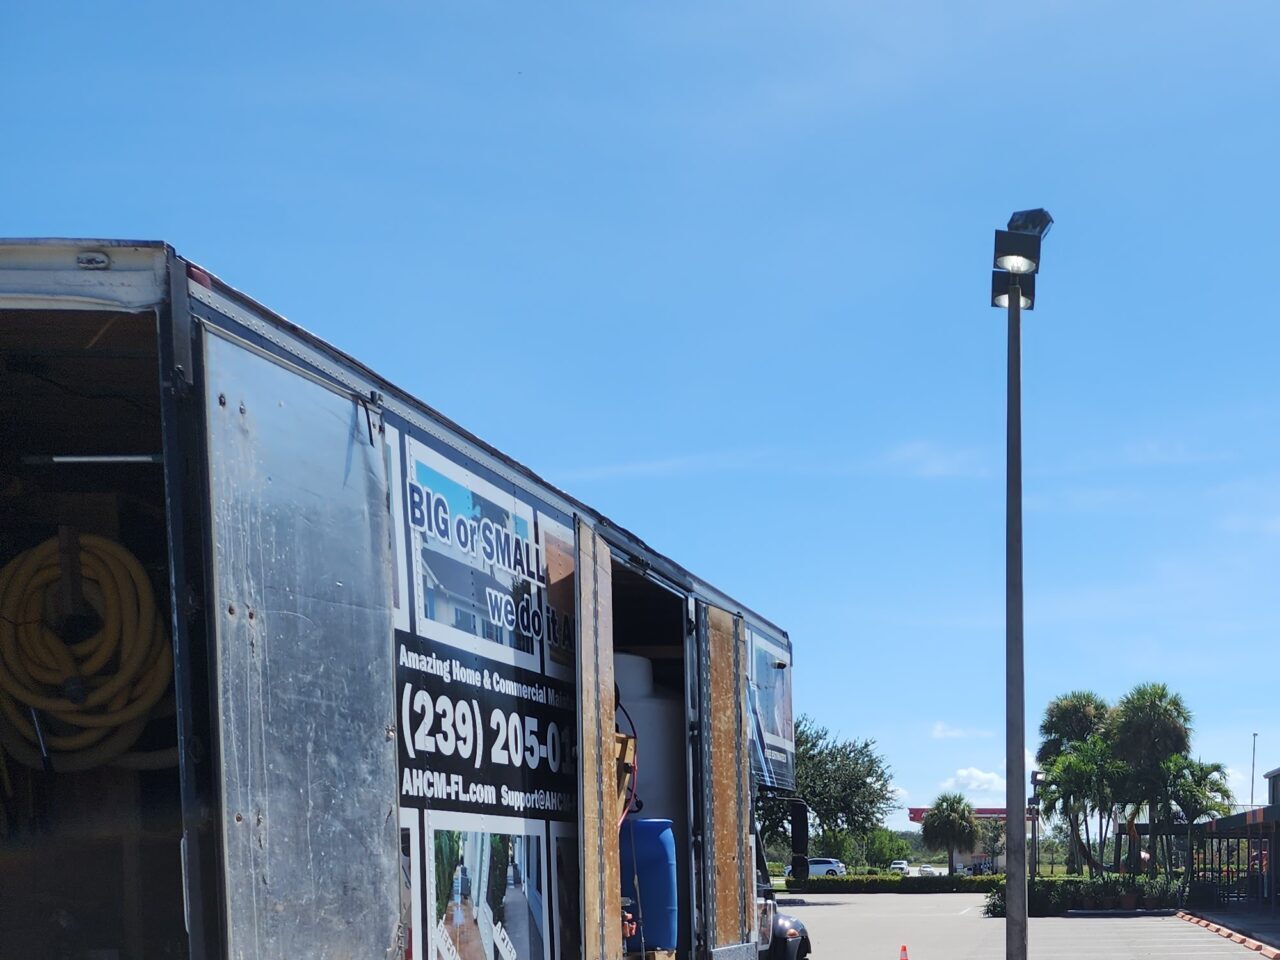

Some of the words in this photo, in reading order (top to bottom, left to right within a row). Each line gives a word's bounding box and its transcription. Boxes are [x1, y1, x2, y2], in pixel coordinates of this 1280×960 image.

[408, 481, 451, 545] BIG
[455, 514, 477, 557] or
[480, 517, 546, 587] SMALL
[486, 587, 516, 630] we
[518, 593, 543, 639] do
[400, 643, 450, 683] Amazing
[452, 658, 481, 687] Home
[483, 668, 491, 690] &
[493, 671, 546, 704] Commercial
[402, 683, 484, 769] (239)
[402, 767, 496, 805] AHCM-FL.com
